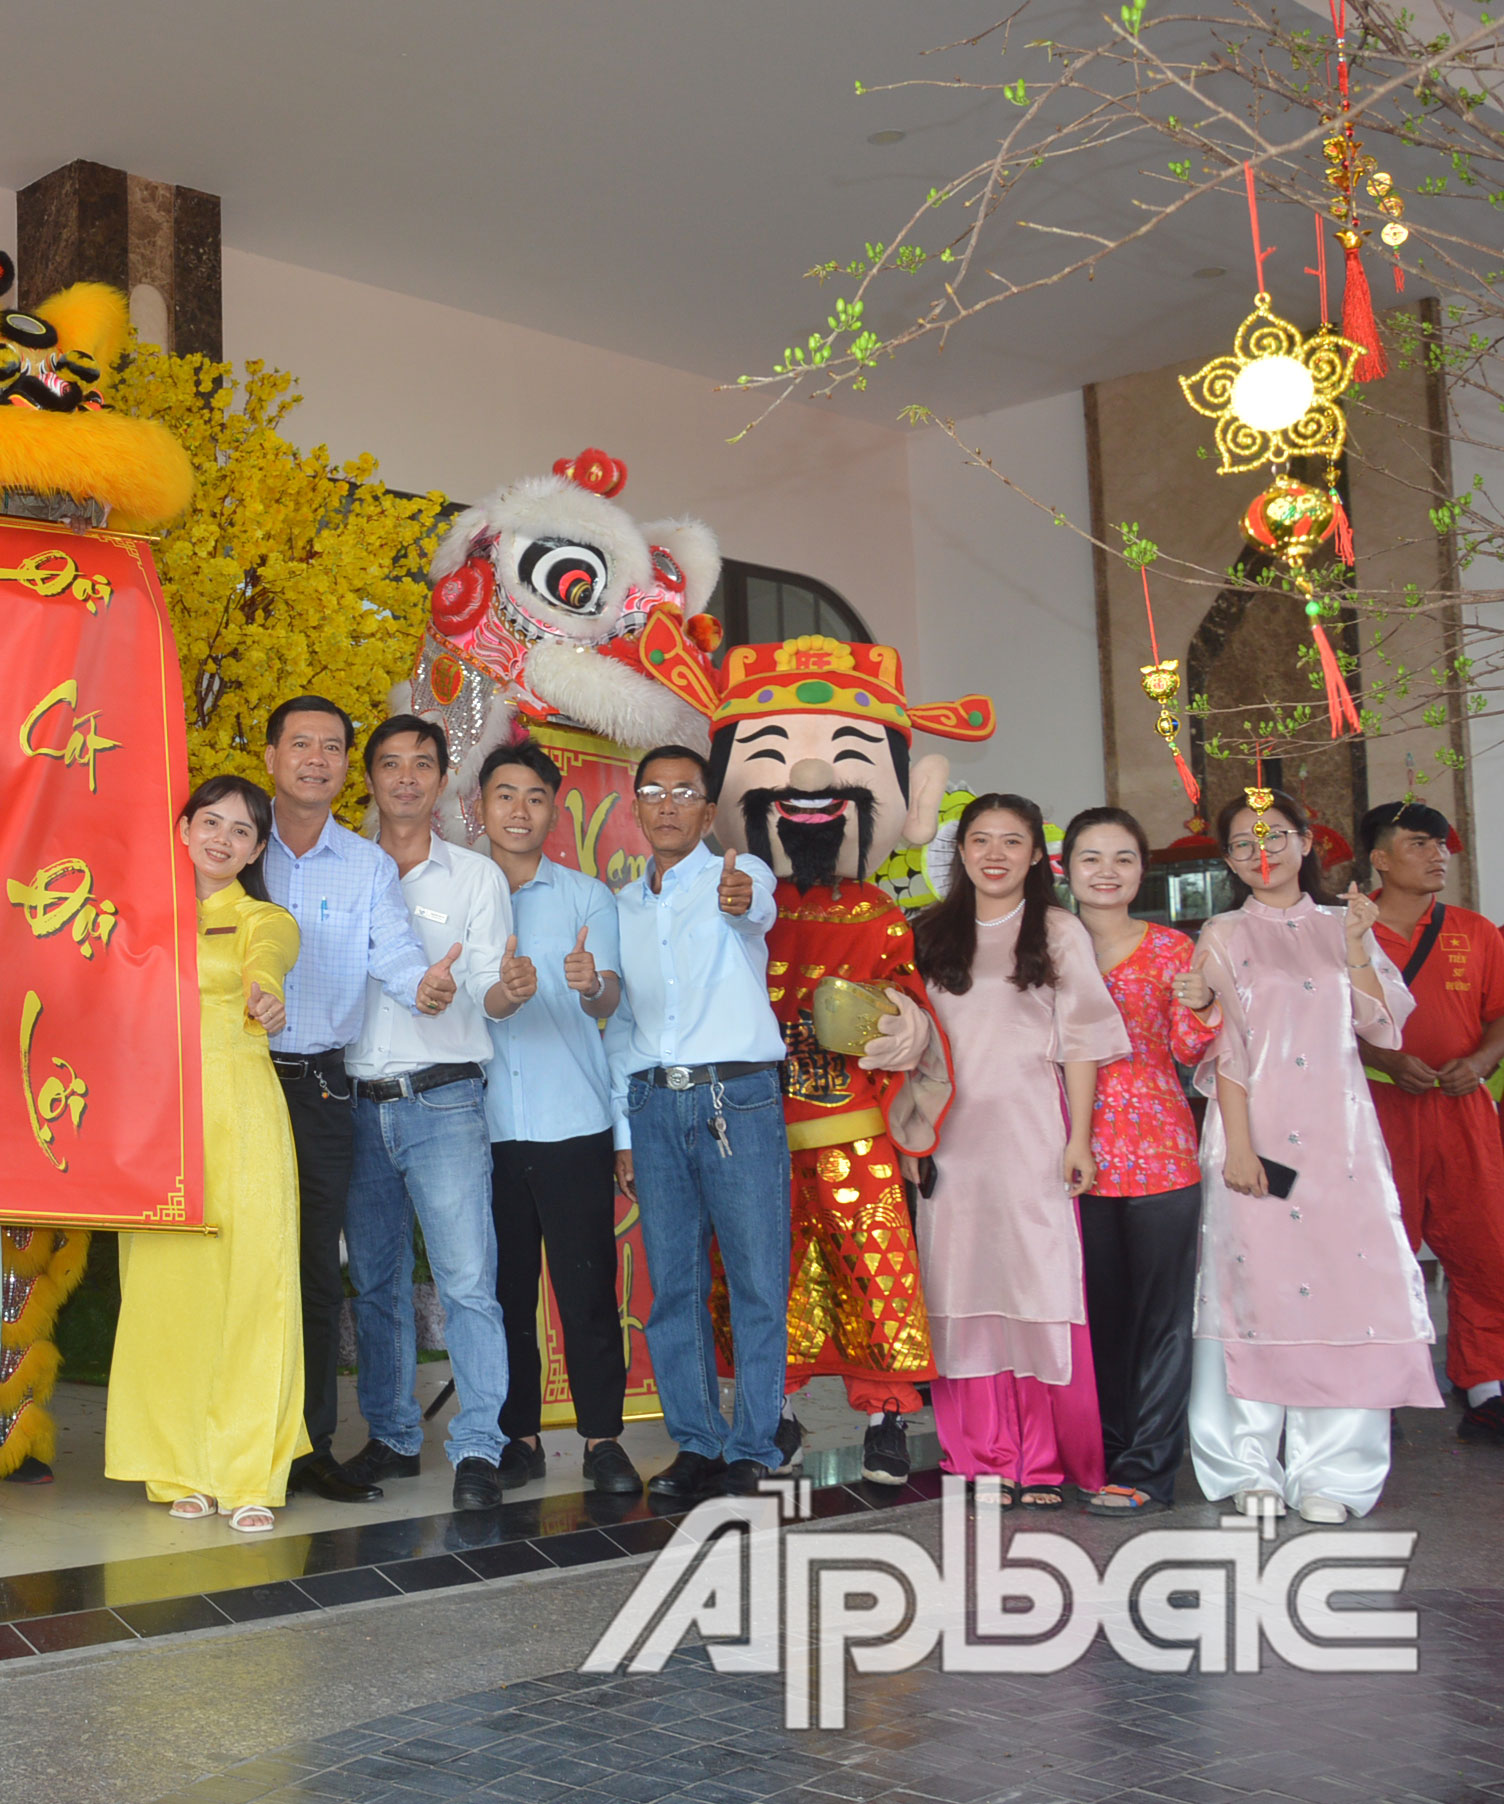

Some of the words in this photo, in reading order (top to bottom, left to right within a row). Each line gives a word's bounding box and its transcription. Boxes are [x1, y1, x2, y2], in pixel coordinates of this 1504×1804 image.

[19, 679, 124, 793] Cát
[7, 857, 118, 957] Đại
[19, 989, 89, 1172] Lợi
